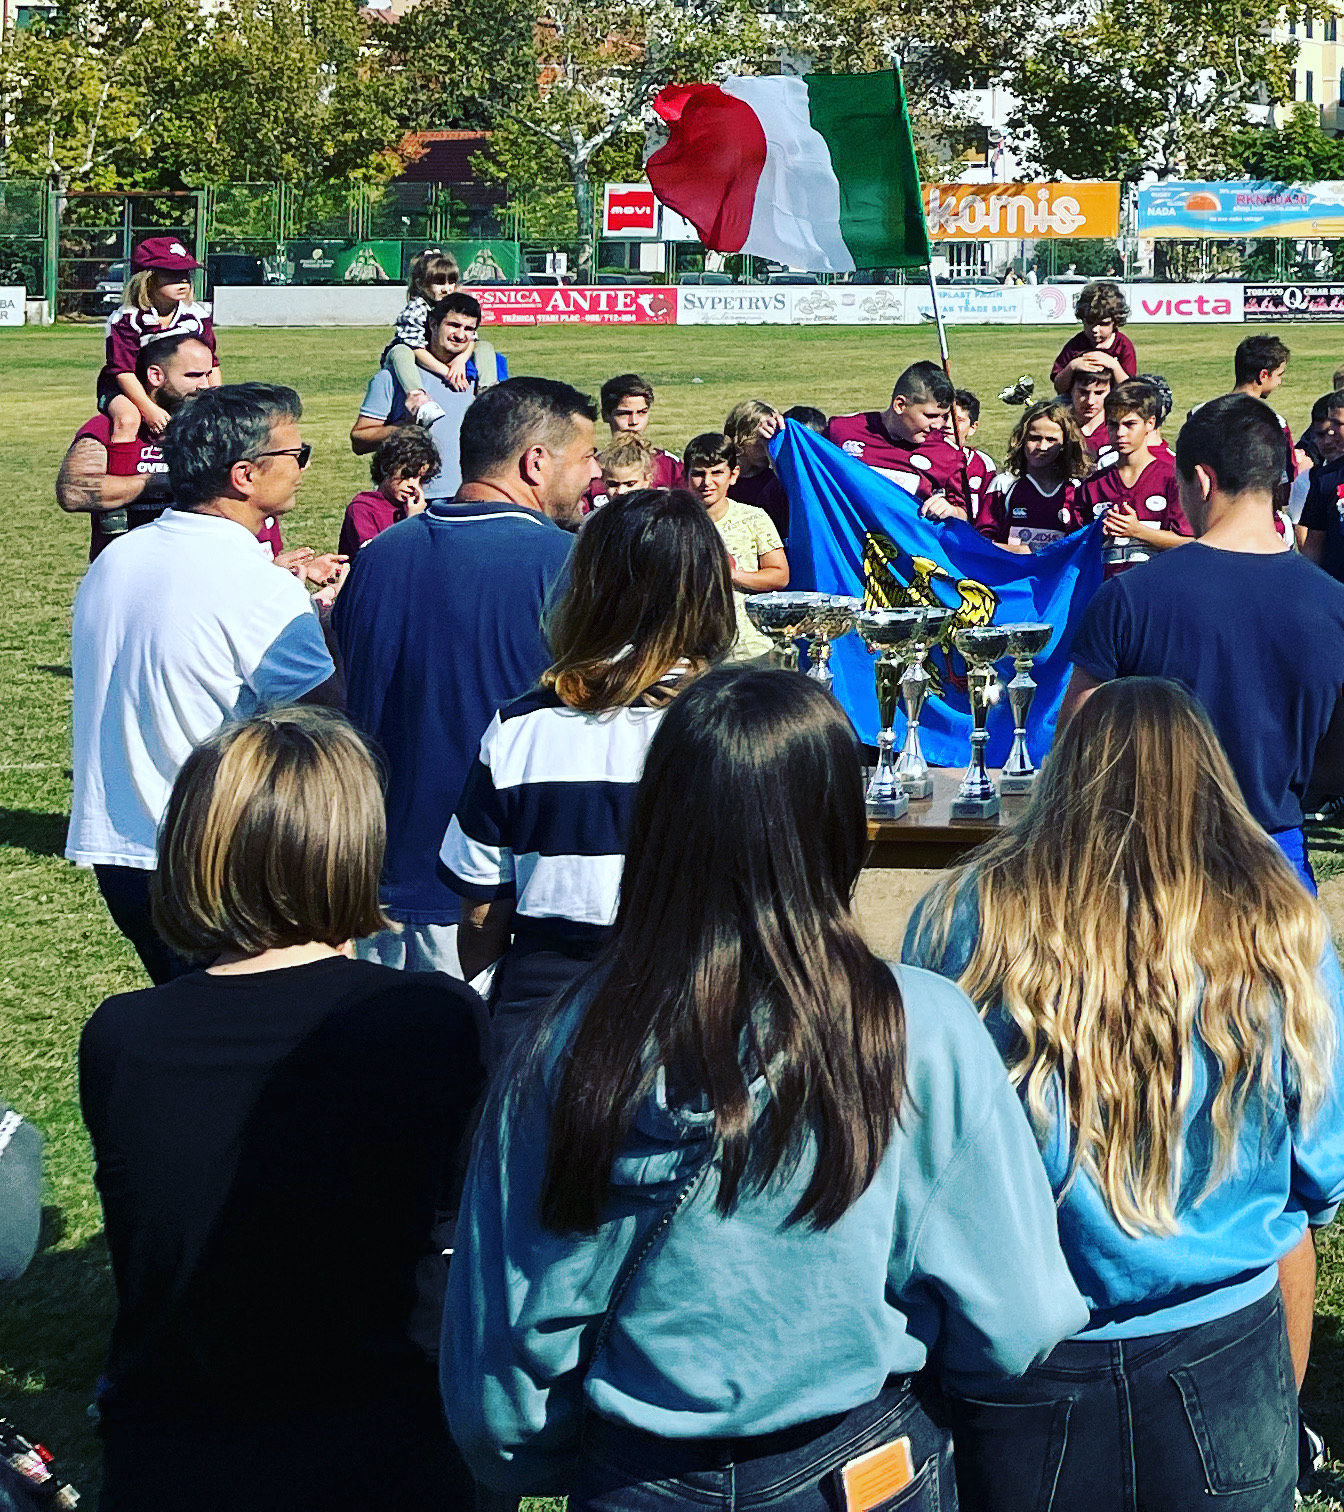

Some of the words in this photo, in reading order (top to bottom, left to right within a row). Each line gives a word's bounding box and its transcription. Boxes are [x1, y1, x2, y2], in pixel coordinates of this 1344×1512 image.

[1147, 207, 1177, 217] NADA
[546, 290, 636, 312] ANTE
[1141, 295, 1232, 316] victa
